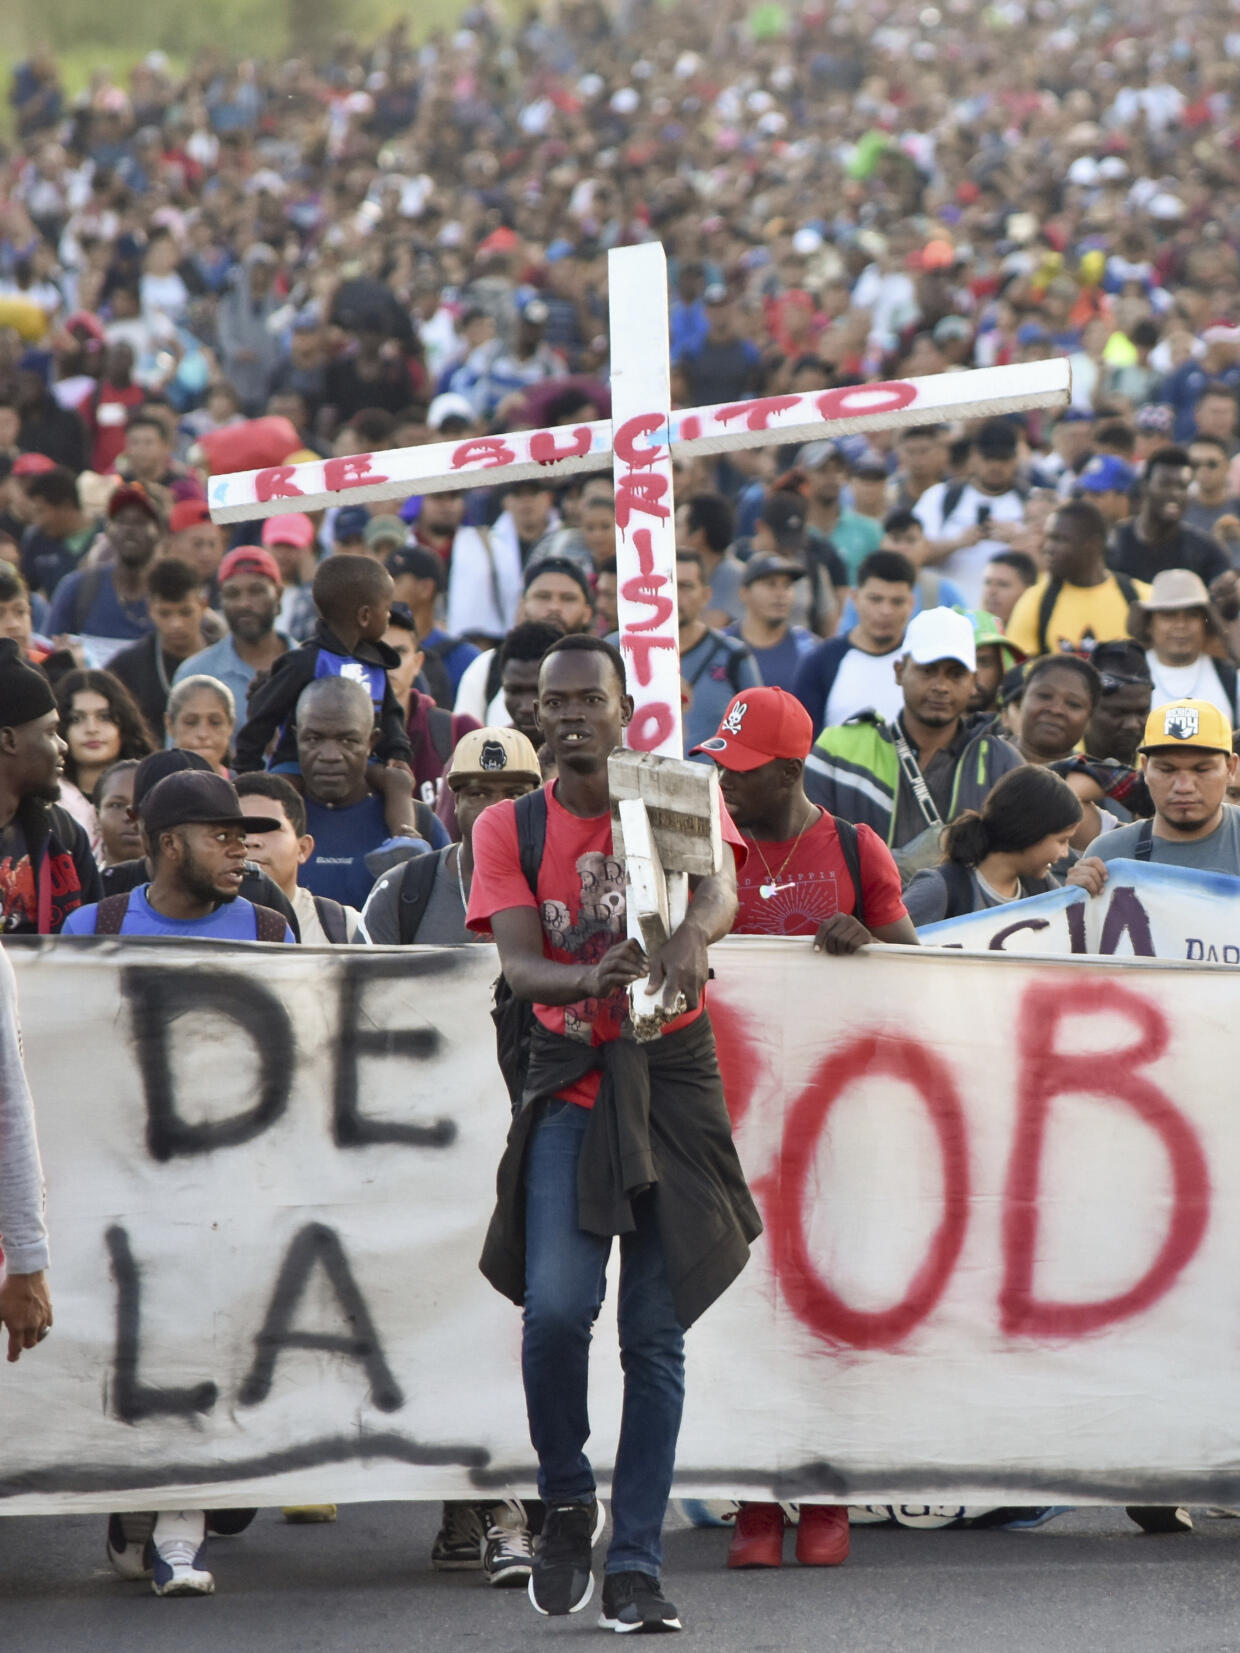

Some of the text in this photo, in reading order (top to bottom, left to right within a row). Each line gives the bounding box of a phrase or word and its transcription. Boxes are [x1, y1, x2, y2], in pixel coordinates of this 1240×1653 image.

[613, 413, 675, 752] CRISTO
[911, 776, 932, 803] PINK
[120, 951, 464, 1163] DE
[104, 1221, 405, 1424] LA
